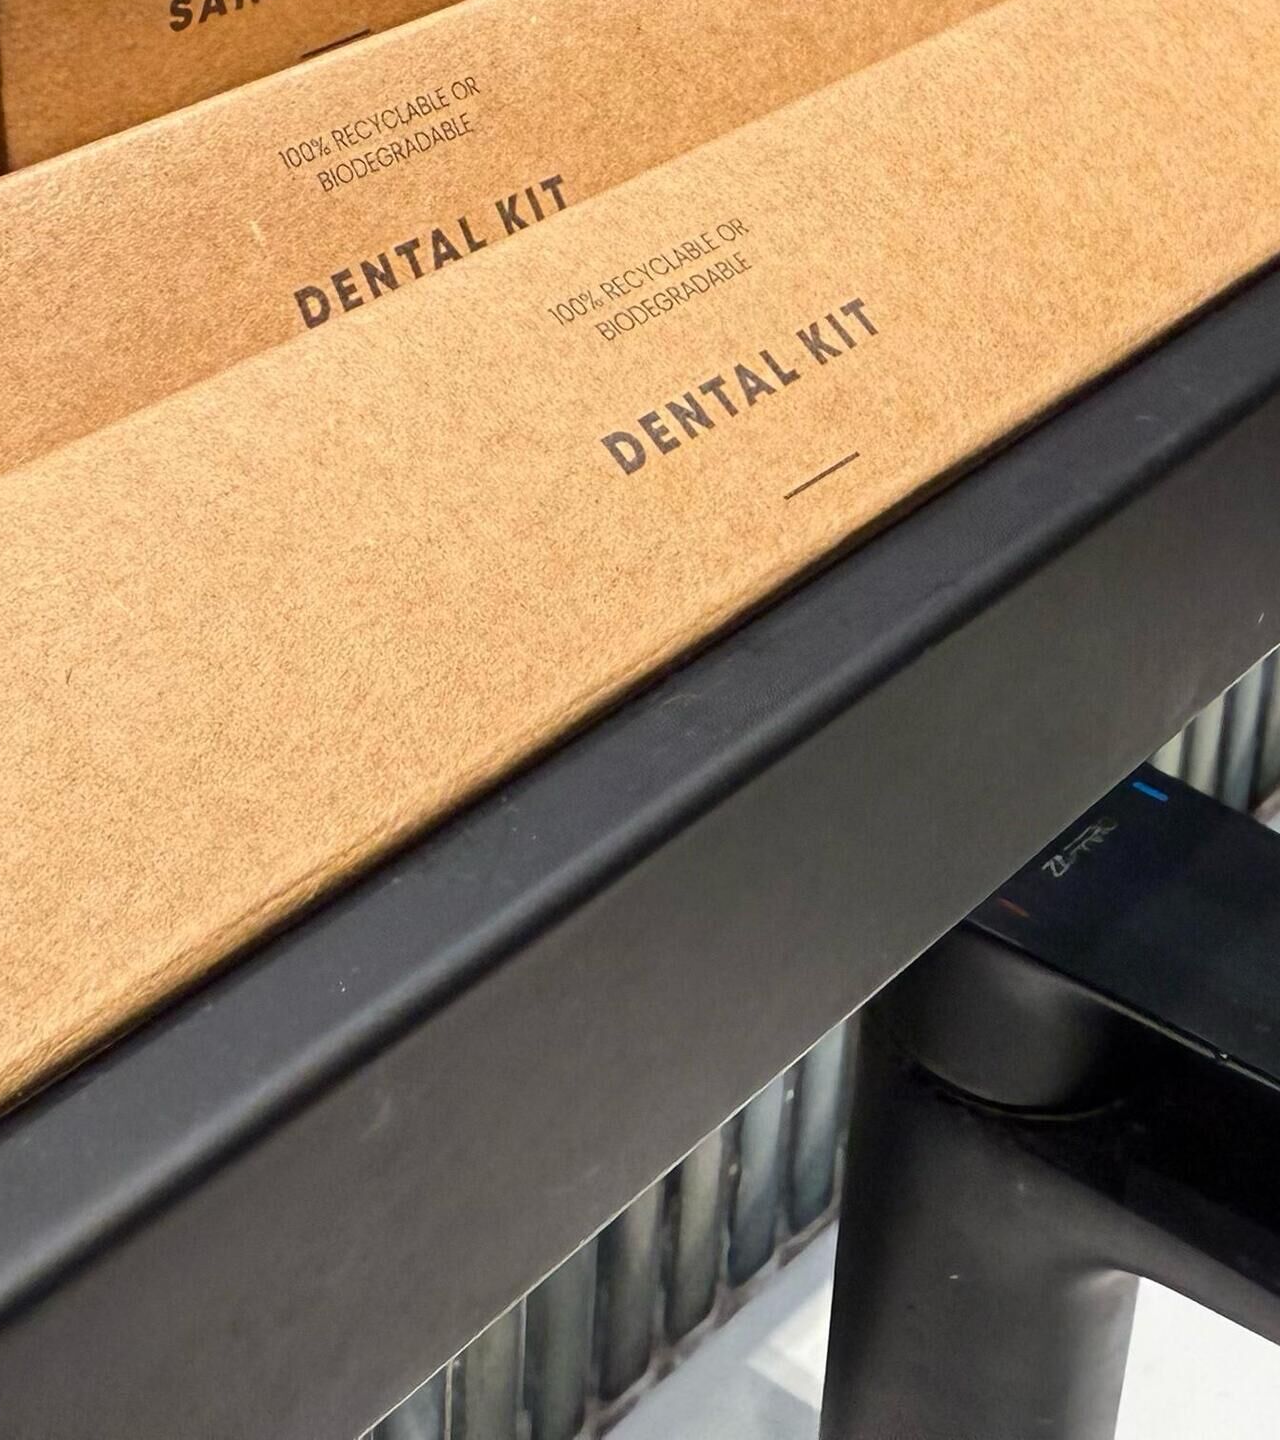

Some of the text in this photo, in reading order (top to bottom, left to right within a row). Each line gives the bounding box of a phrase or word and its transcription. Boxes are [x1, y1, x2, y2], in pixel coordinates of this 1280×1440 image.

[279, 76, 481, 170] 100% RECYCLABLE OR
[317, 113, 474, 193] BIODEGRADABLE
[294, 174, 568, 330] DENTAL KIT
[547, 217, 749, 326] 100% RECYCLABLE OR
[595, 252, 752, 342] BIODEGRADABLE
[600, 298, 879, 476] DENTAL KIT
